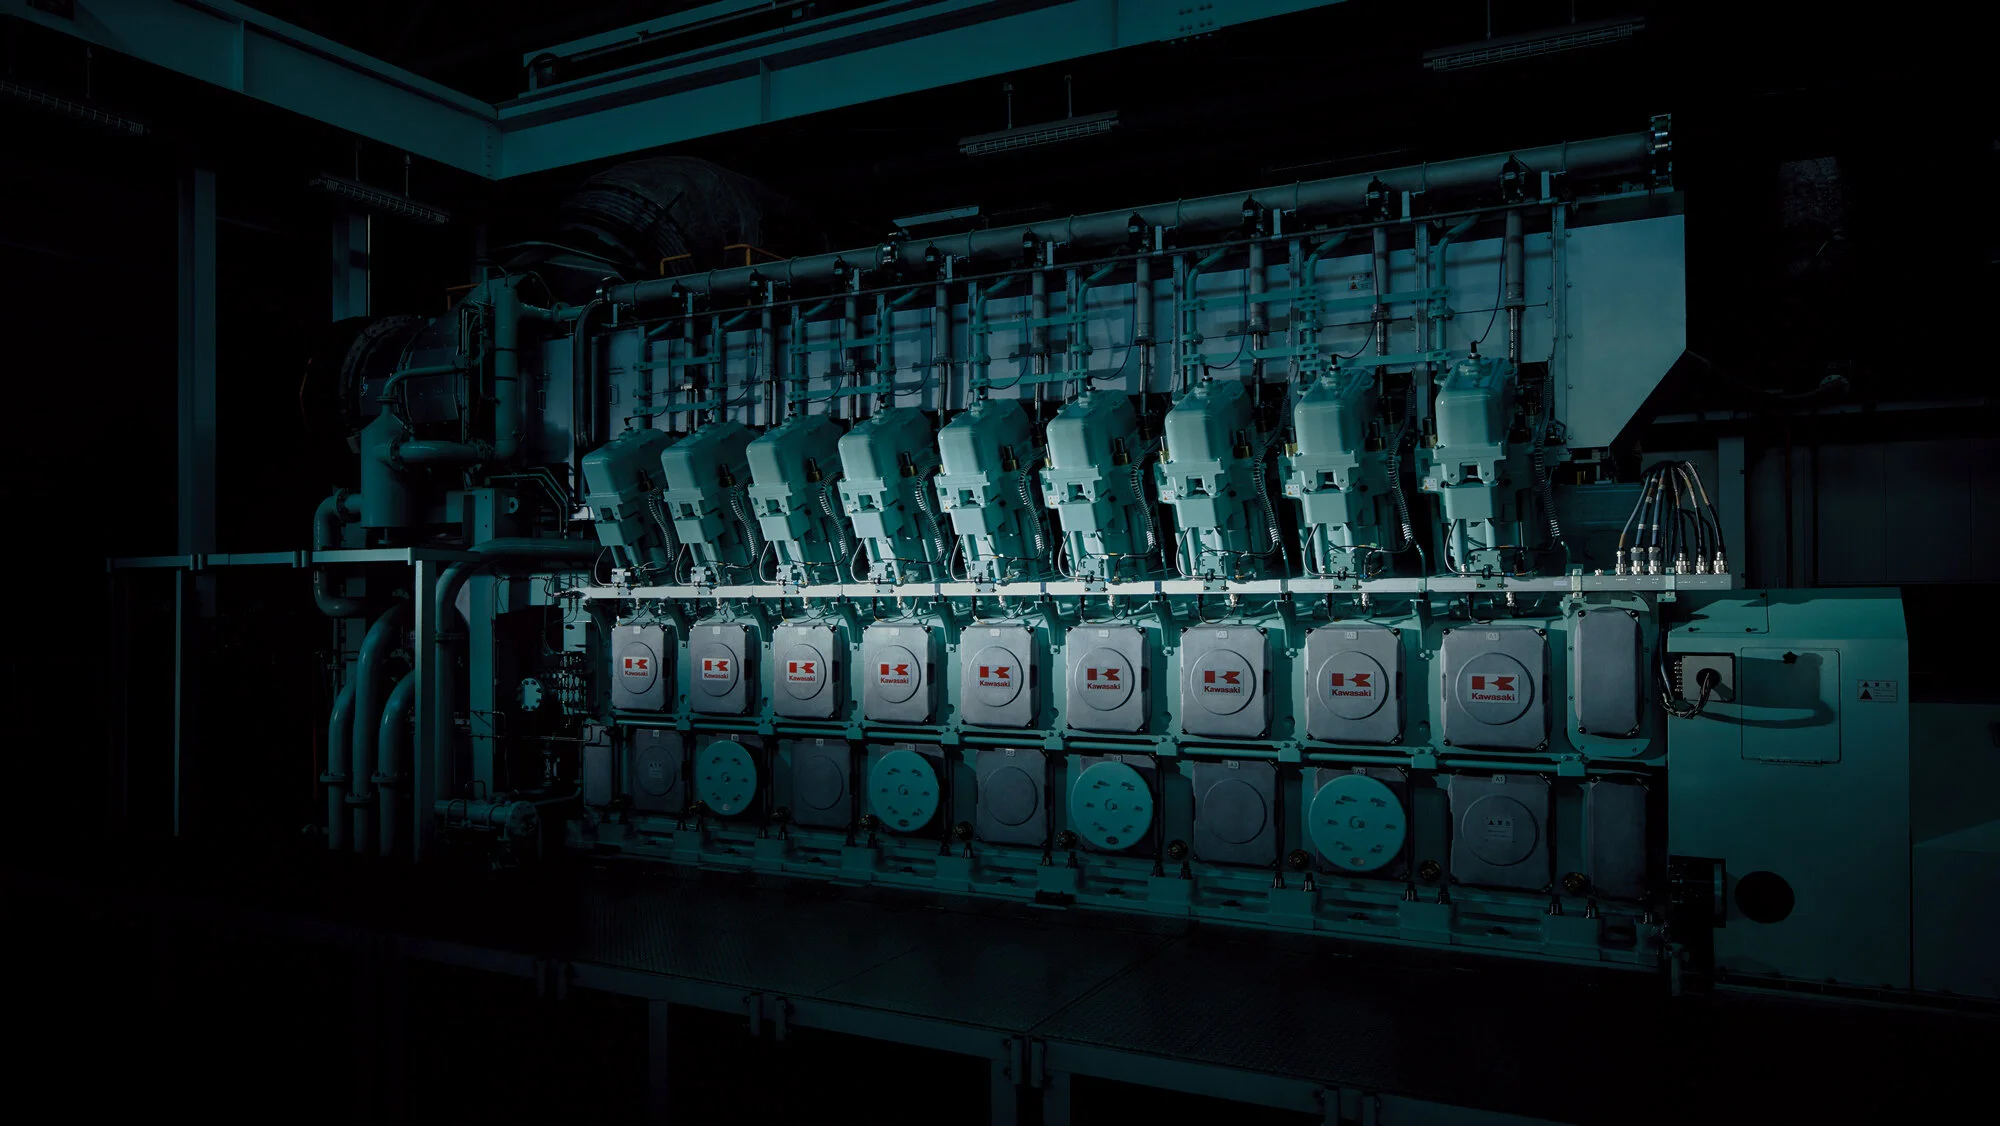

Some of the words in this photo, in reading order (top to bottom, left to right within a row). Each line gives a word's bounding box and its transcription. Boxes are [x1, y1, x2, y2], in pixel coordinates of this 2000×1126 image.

[980, 680, 1010, 688] Kawasaki
[1204, 686, 1240, 694] Kawasaki
[1332, 689, 1371, 697] Kawasaki
[1472, 693, 1516, 702] Kawasaki
